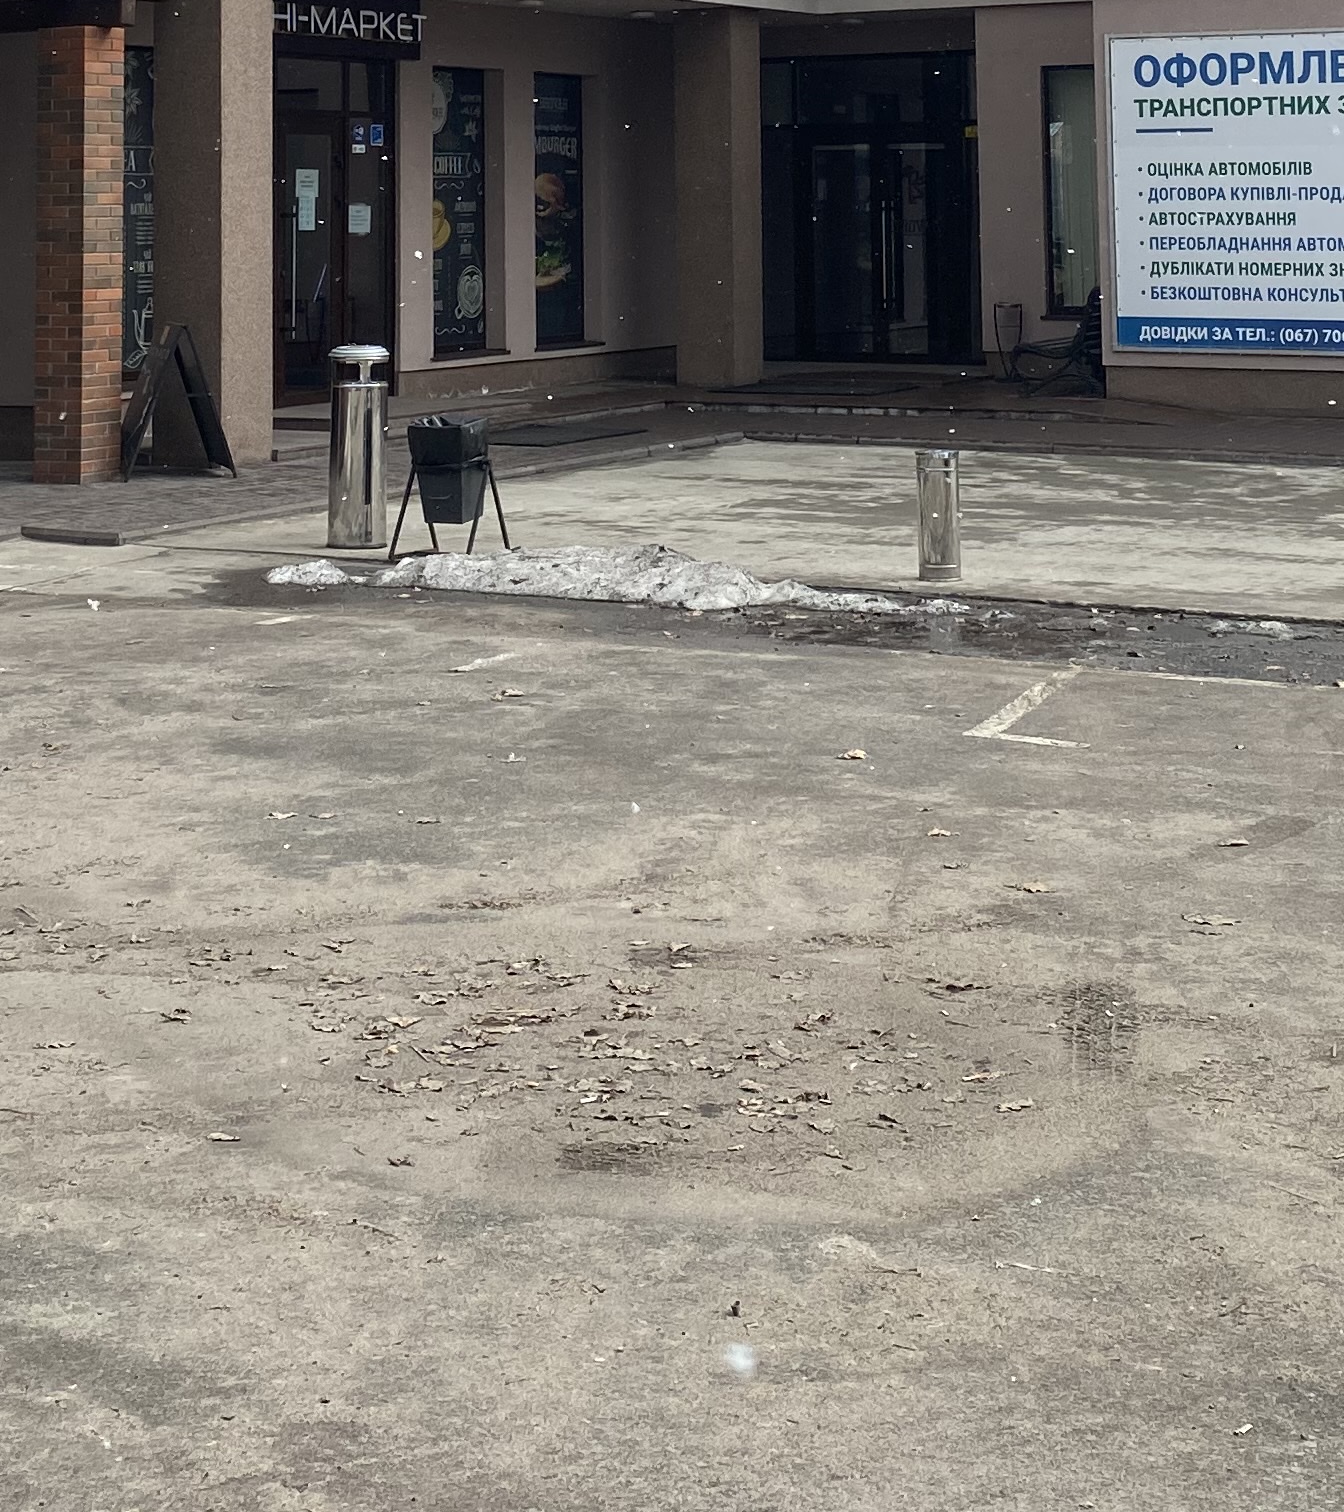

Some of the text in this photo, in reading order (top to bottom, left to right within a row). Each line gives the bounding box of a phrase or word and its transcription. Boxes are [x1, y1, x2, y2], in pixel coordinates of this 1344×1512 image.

[1133, 94, 1331, 118] ТРАНСПОРТНИХ
[1147, 161, 1313, 179] ОЦІНКА АВТОМОБІЛІВ
[1148, 187, 1227, 204] ДОГОВОРА
[1148, 212, 1296, 226] АВТОСТРАХУВАННЯ
[1149, 236, 1292, 254] ПЕРЕОБЛАДНАННЯ
[1150, 261, 1234, 278] ДУБЛІКАТИ
[1238, 262, 1325, 277] НОМЕРНИХ
[1150, 286, 1263, 302] БЕЗКОШТОВНА
[1139, 326, 1207, 342] ДОВІДКИ
[1212, 327, 1233, 341] ЗА
[1236, 328, 1275, 342] ТЕЛ.:
[1279, 328, 1318, 345] (067)
